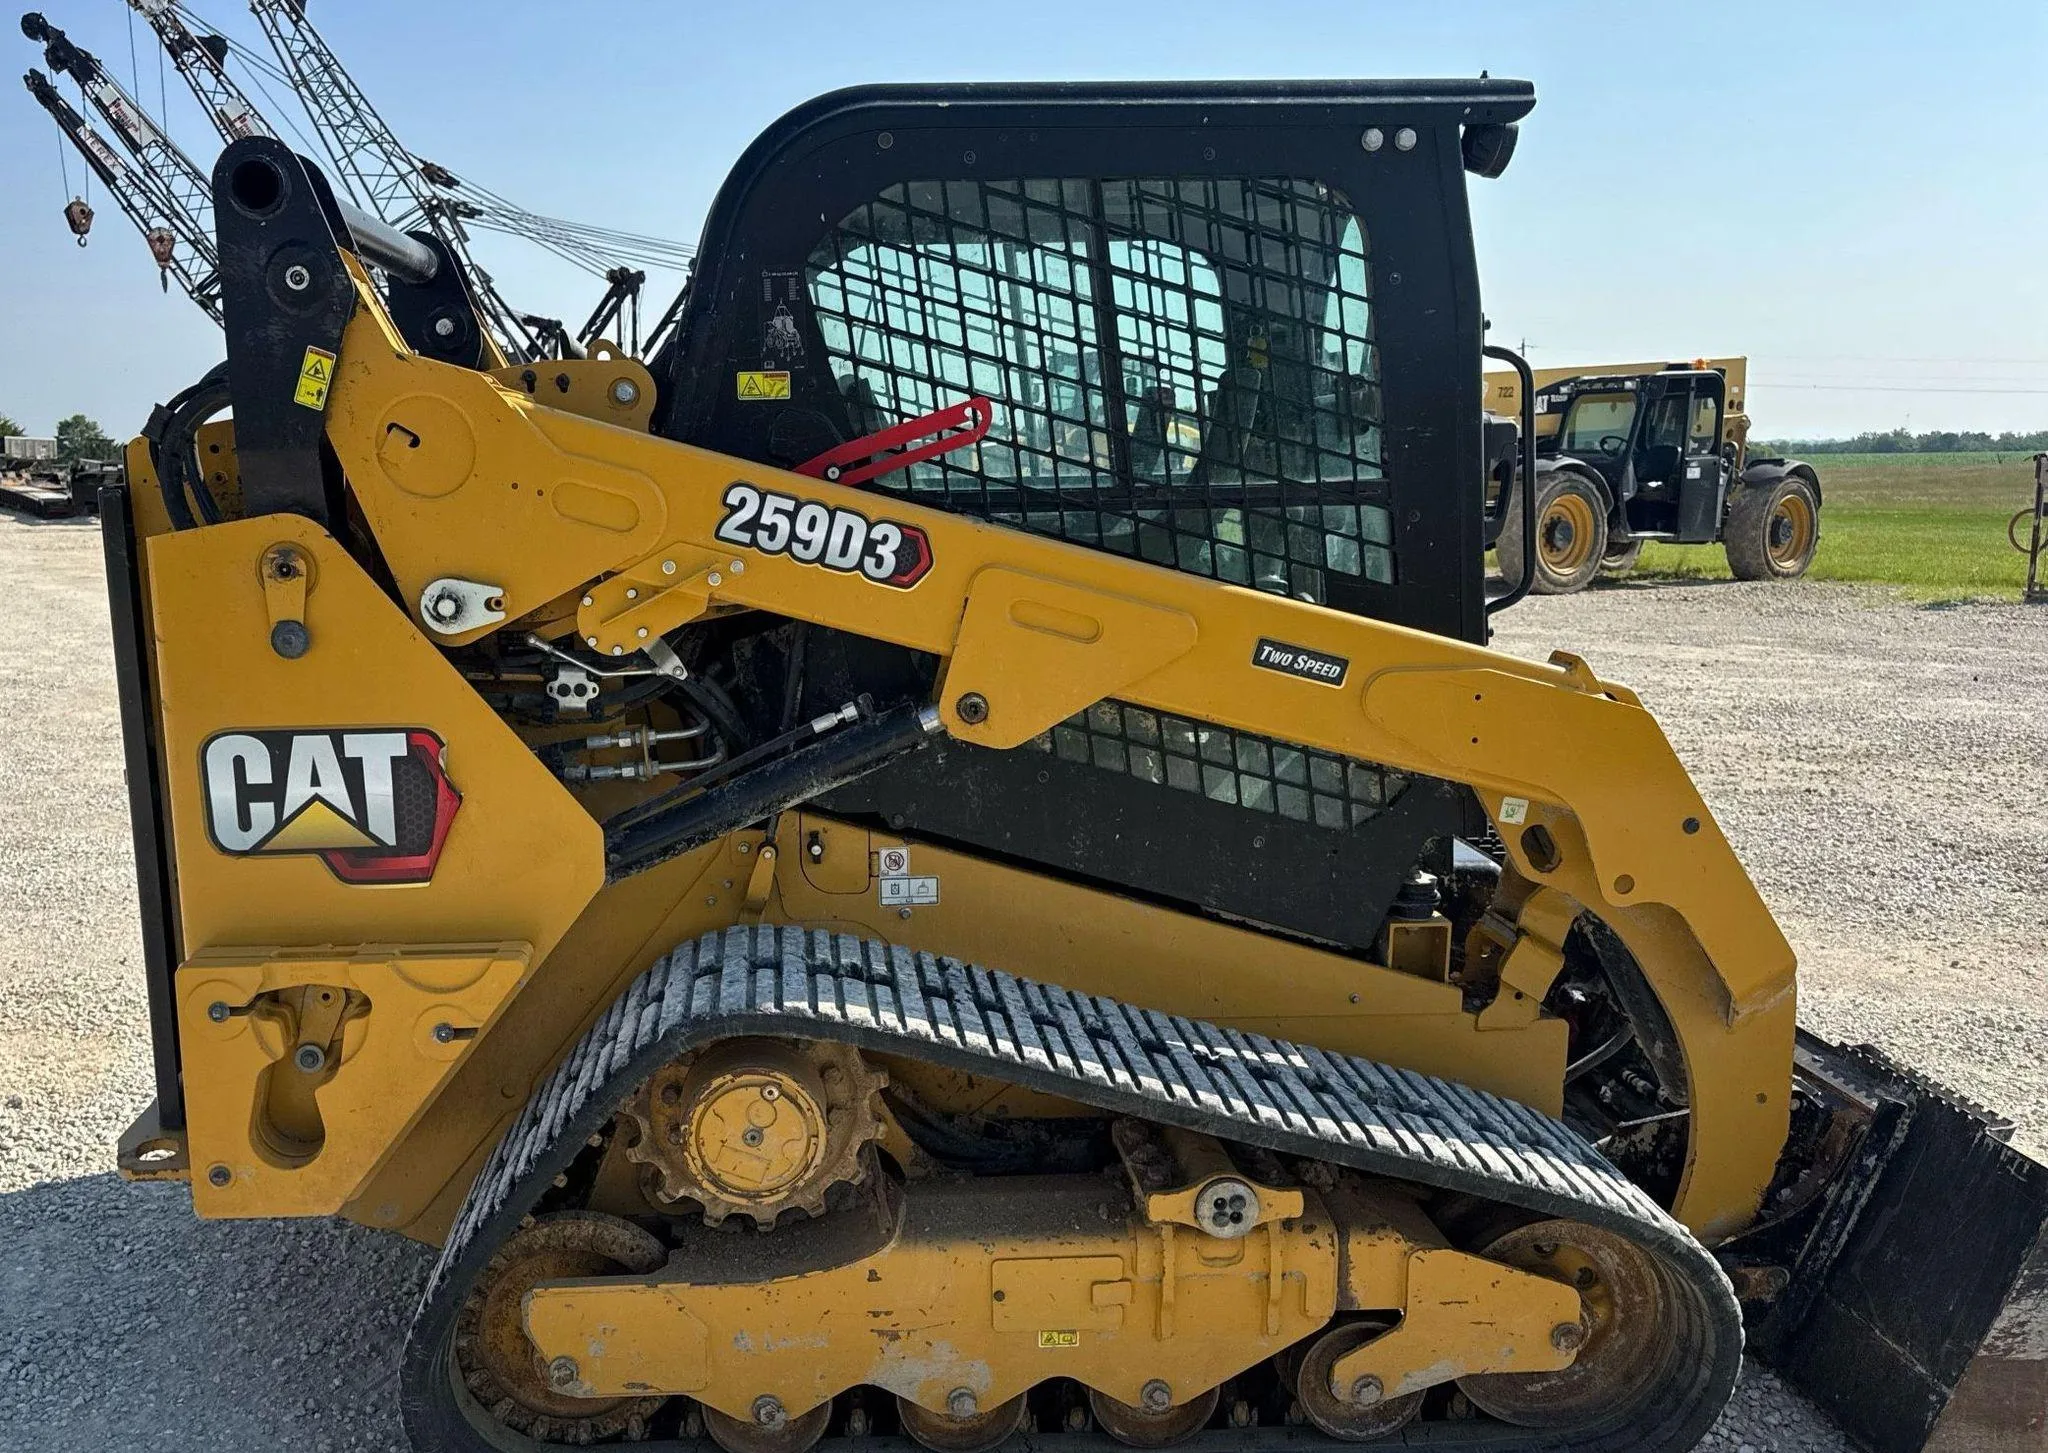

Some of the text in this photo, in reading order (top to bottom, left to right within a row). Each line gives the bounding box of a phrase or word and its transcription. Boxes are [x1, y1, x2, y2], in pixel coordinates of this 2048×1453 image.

[84, 131, 118, 170] TEREX
[1498, 387, 1514, 398] 722
[1535, 395, 1549, 413] AT
[718, 486, 902, 579] 259D3
[206, 733, 408, 851] CAT
